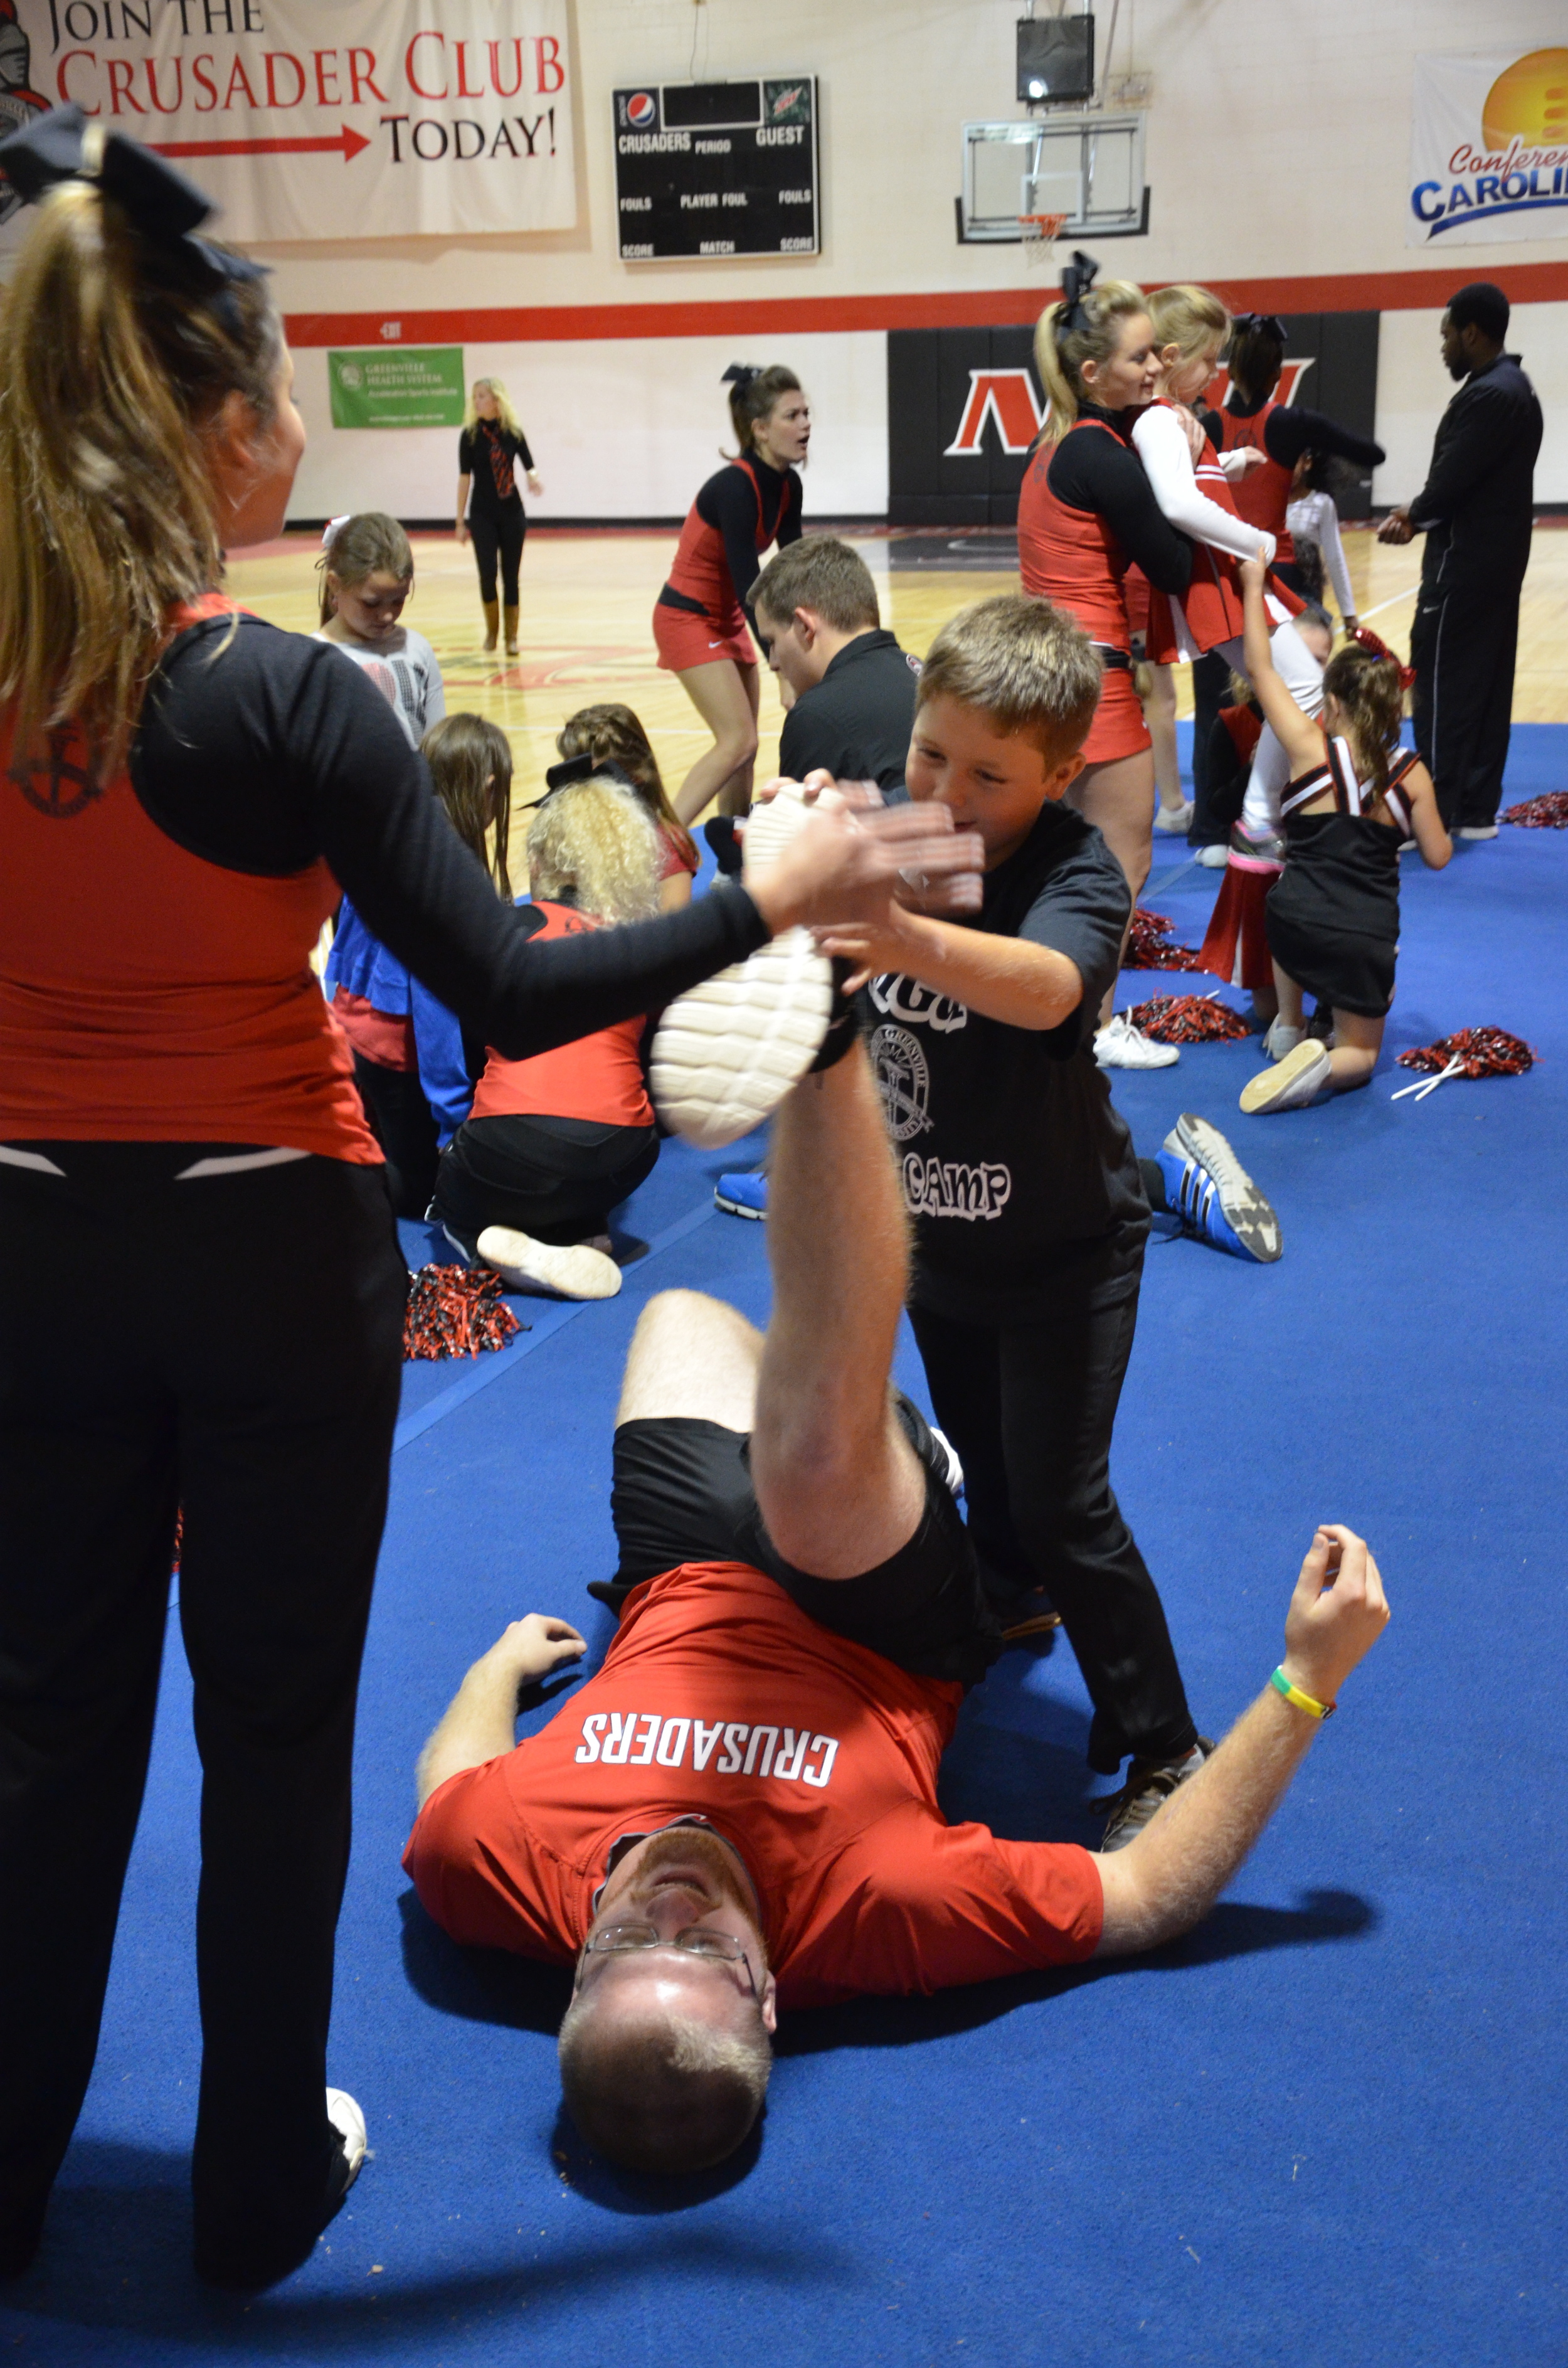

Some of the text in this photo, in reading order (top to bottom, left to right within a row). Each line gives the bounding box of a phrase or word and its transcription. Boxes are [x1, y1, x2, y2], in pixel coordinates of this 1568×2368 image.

[51, 0, 265, 52] JOIN THE
[56, 47, 388, 117] CRUSADER
[405, 31, 565, 100] CLUB
[380, 107, 558, 163] TODAY!
[618, 132, 691, 154] CRUSADERS
[756, 125, 804, 146] GUEST
[695, 139, 731, 154] PERIOD
[620, 196, 652, 211] FOULS
[681, 193, 748, 209] PLAYER FOUL
[779, 189, 812, 204] FOULS
[1411, 167, 1568, 222] CAROLI
[622, 243, 654, 258] SCORE
[700, 240, 735, 255] MATCH
[781, 236, 814, 251] SCORE
[575, 1712, 840, 1788] CRUSADERS
